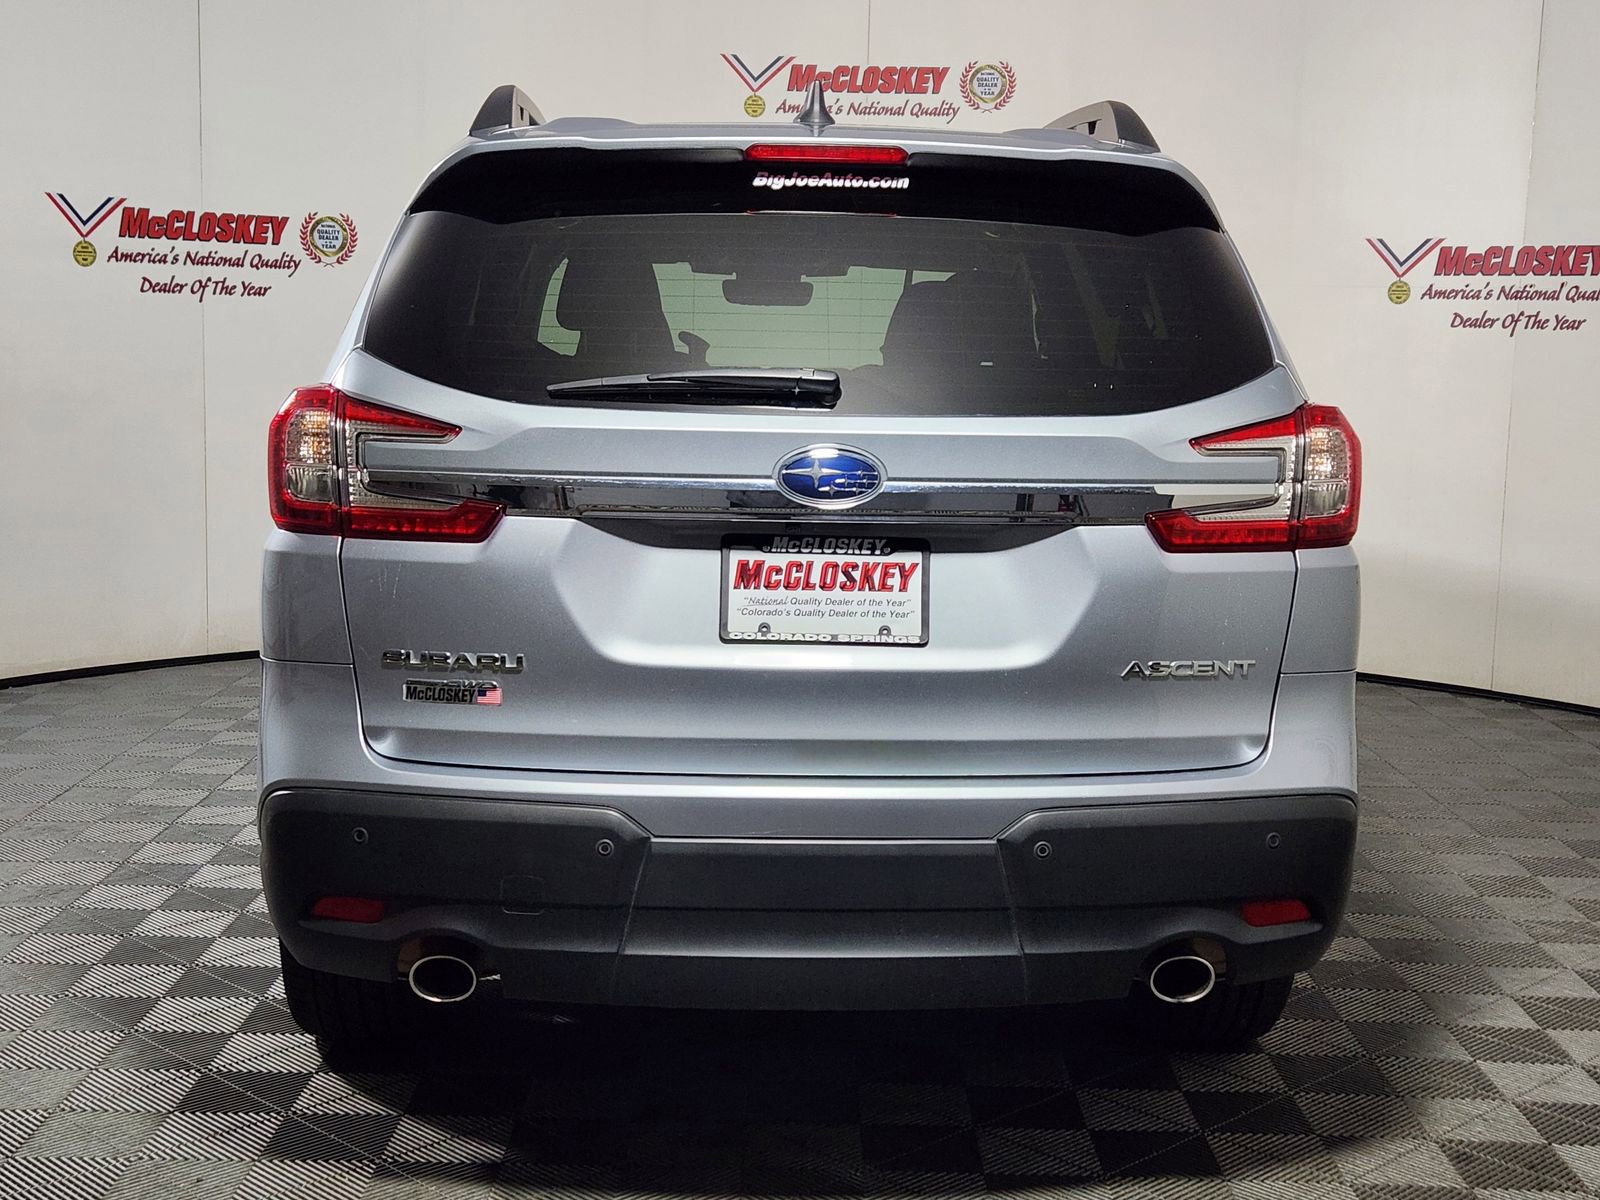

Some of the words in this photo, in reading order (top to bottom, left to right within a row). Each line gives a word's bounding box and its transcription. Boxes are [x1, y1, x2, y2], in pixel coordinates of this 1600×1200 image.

[787, 64, 951, 94] McCLOSKEY
[846, 100, 905, 117] National
[910, 101, 960, 124] Quality
[118, 206, 290, 245] McCLOSKEY
[107, 246, 180, 266] America's
[183, 249, 245, 269] National
[249, 252, 302, 277] Quality
[140, 276, 188, 295] Dealer
[190, 276, 211, 303] Of
[212, 277, 237, 296] The
[240, 280, 272, 297] Year
[1420, 281, 1493, 301] America's
[1497, 282, 1565, 301] National
[1450, 310, 1500, 329] Dealer
[1501, 310, 1524, 337] Of
[1523, 311, 1550, 330] The
[1552, 314, 1587, 332] Year
[771, 536, 887, 555] McCLOSKEY
[733, 559, 920, 592] McCLOSKEY
[790, 597, 822, 607] Quality
[825, 597, 854, 606] Dealer
[868, 599, 883, 607] the
[793, 608, 826, 619] Quality
[828, 609, 858, 617] Dealer
[872, 610, 887, 618] the
[729, 631, 831, 641] COLORADO
[837, 634, 921, 644] SPRINGS
[381, 649, 525, 674] SUBARU
[1120, 660, 1256, 679] ASCENT
[405, 685, 476, 702] McCLOSKEY
